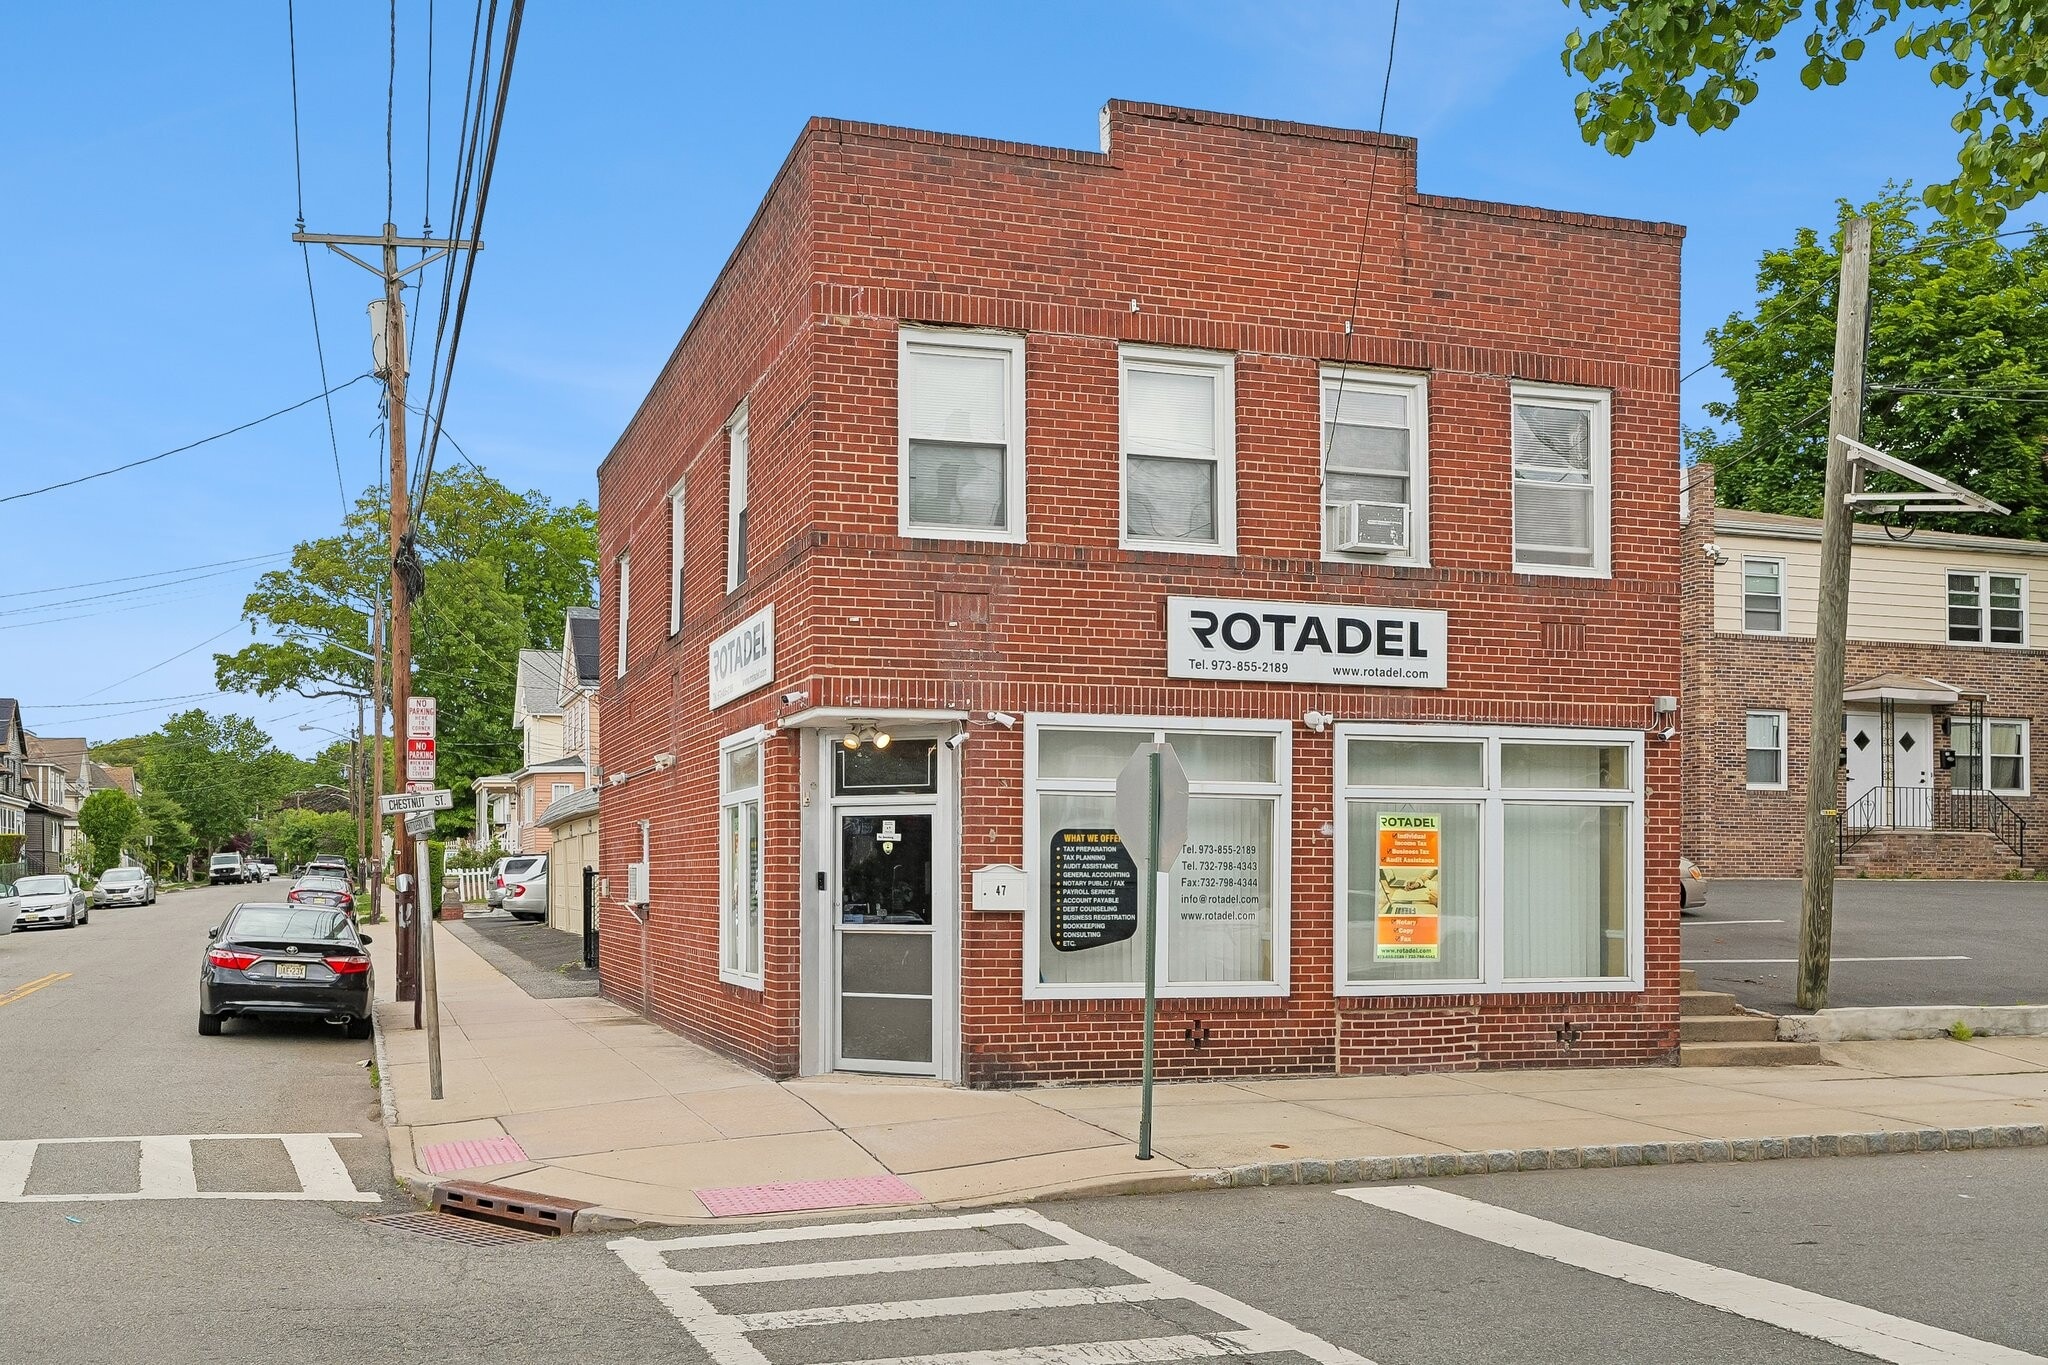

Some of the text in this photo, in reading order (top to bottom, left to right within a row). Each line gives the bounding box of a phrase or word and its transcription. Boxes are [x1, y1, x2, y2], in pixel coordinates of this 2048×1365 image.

[1190, 610, 1428, 658] ROTADEL
[713, 621, 767, 682] ROTADEL
[1188, 658, 1289, 674] Tel. 973-855-2189
[1332, 666, 1429, 679] www.rotadel.com
[416, 699, 427, 708] NO
[409, 707, 434, 716] PARKING
[415, 742, 427, 750] NO
[408, 751, 434, 760] PARKING
[388, 795, 447, 811] CHESTNUT ST.
[1381, 817, 1436, 828] ROTADEL
[1063, 834, 1086, 843] WHAT
[1087, 834, 1099, 843] WE
[1182, 844, 1256, 855] Tel. 973-855-2189
[1182, 861, 1258, 871] Tel. 732-798-4343
[1181, 878, 1258, 887] Fax:732-798-4344
[996, 885, 1006, 896] 47
[1181, 894, 1259, 904] info@rotadel.com
[1180, 911, 1256, 920] www.rotadel.com
